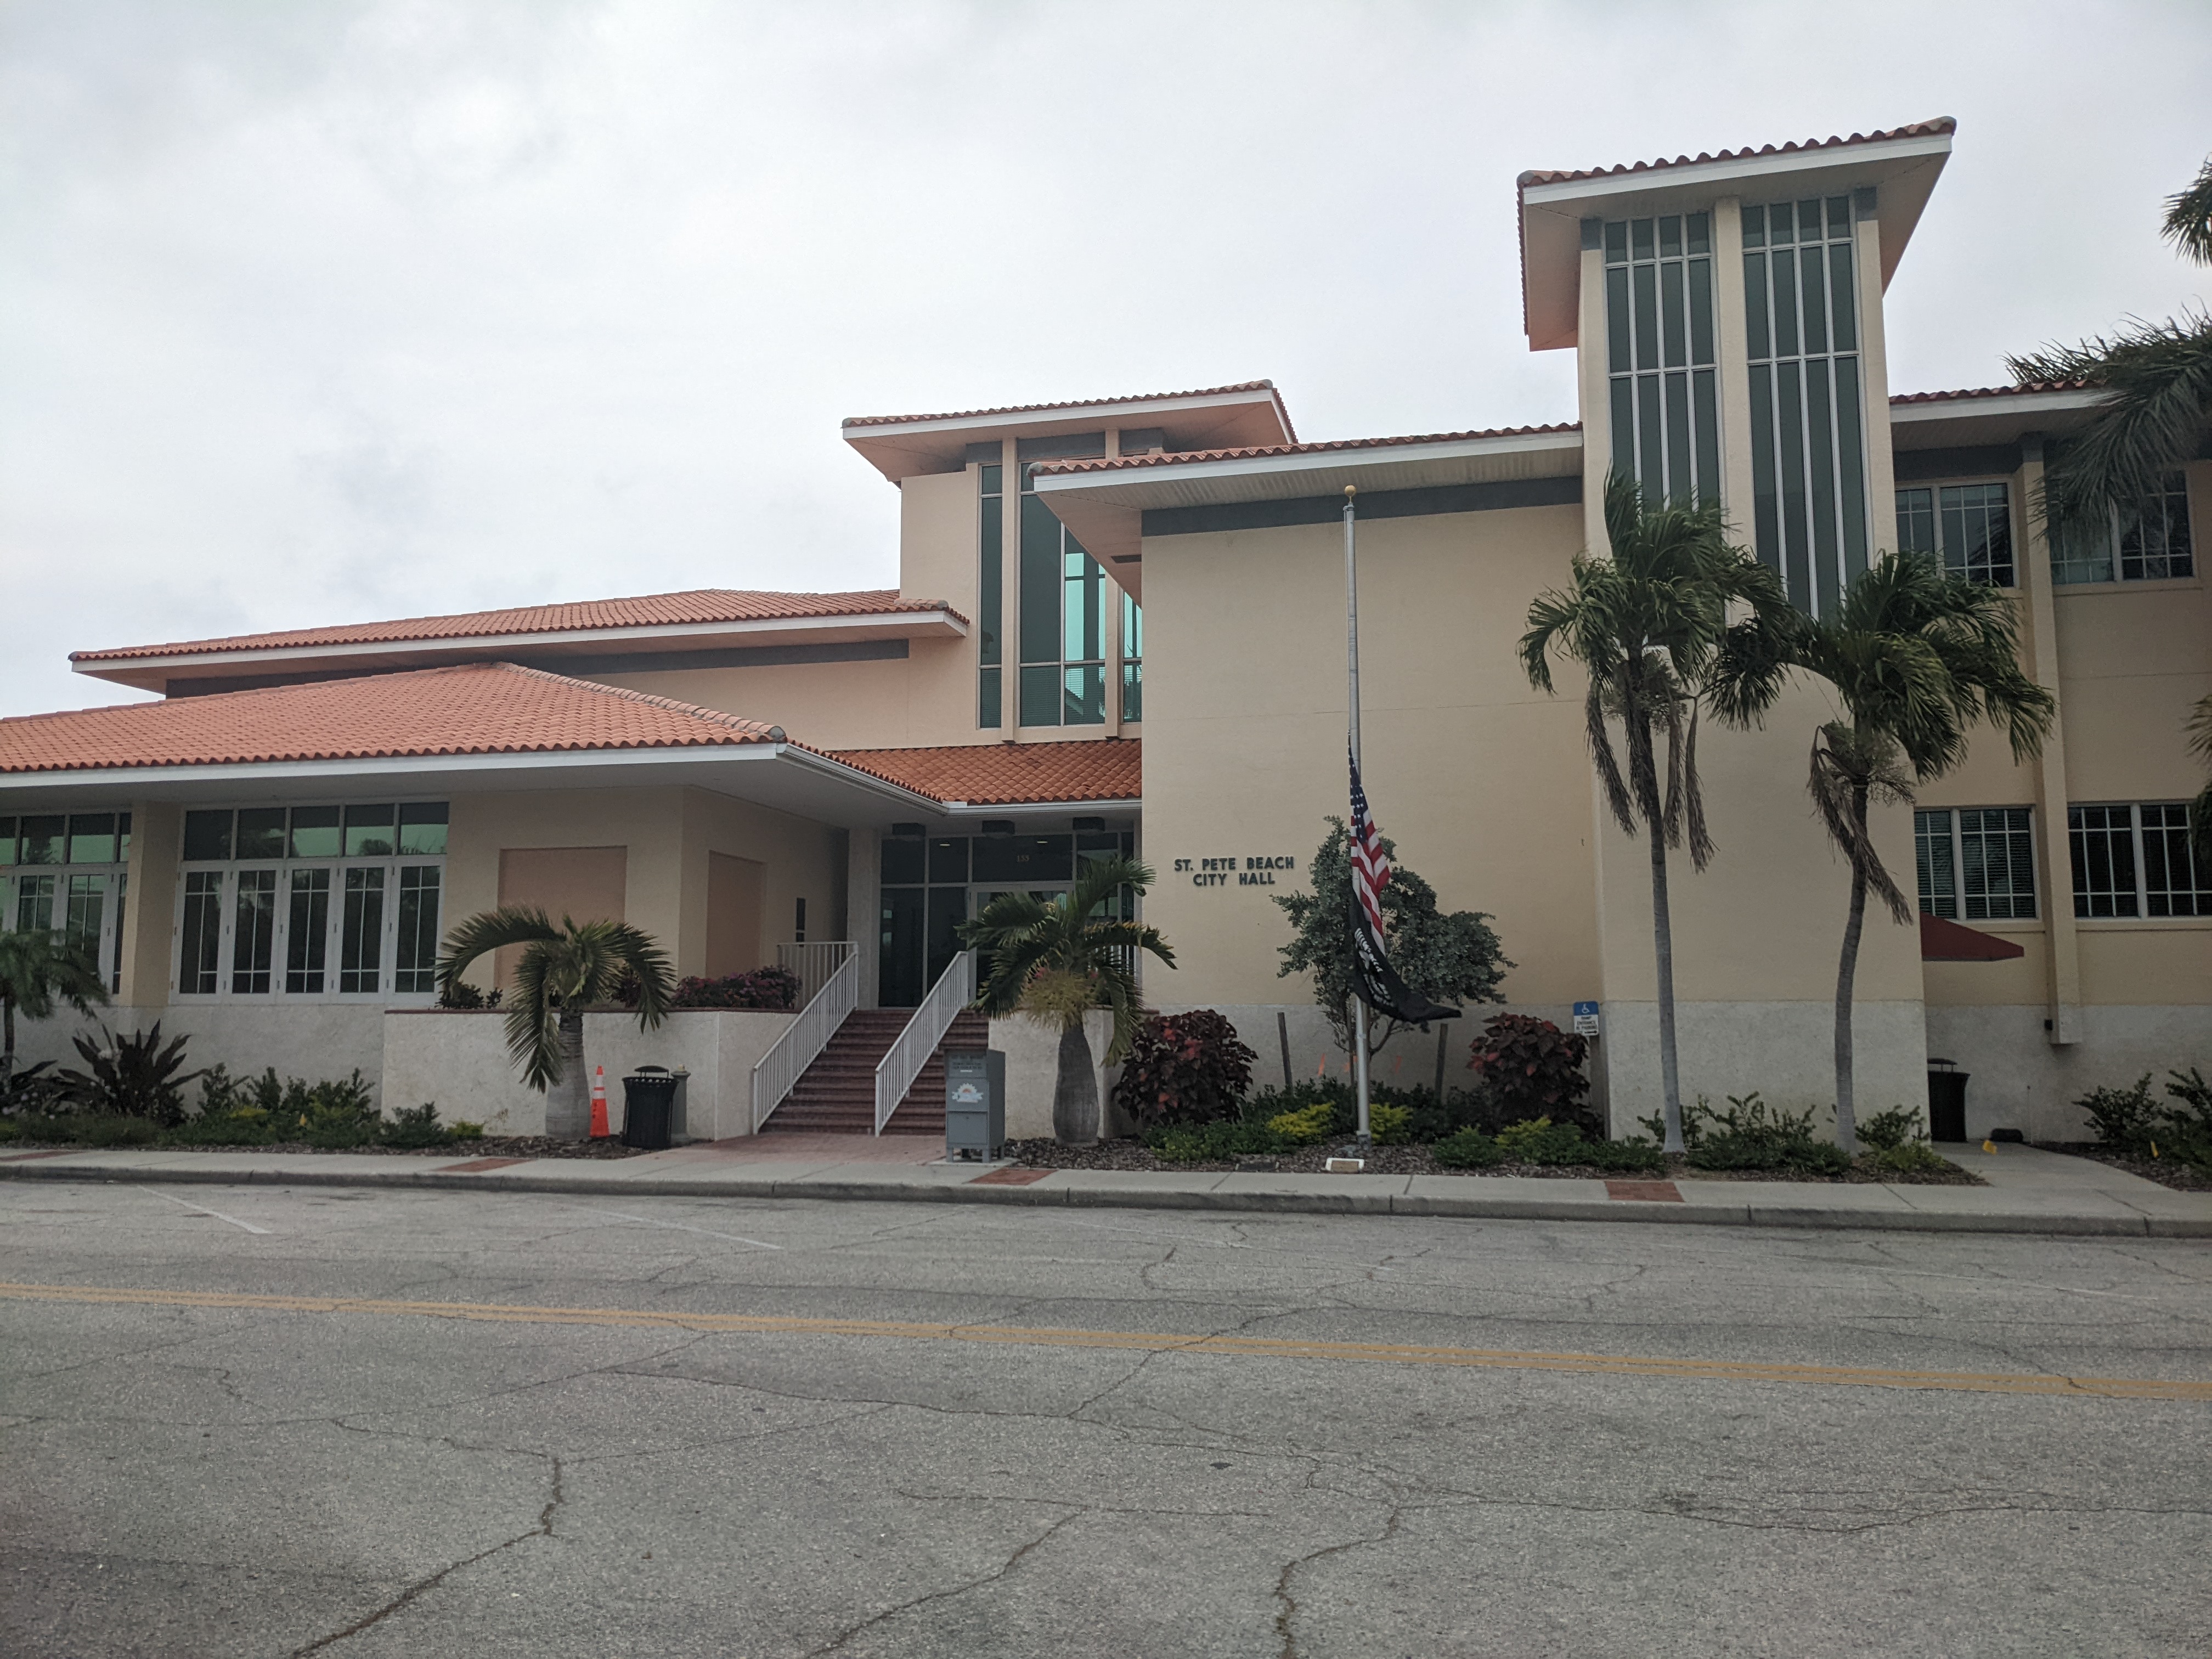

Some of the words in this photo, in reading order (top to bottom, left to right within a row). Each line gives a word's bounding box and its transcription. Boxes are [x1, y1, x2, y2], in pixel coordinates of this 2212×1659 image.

[1174, 859, 1194, 871] ST.
[1202, 857, 1236, 871] PETE
[1246, 856, 1294, 869] BEACH
[1193, 873, 1227, 886] CITY
[1239, 872, 1276, 885] HALL
